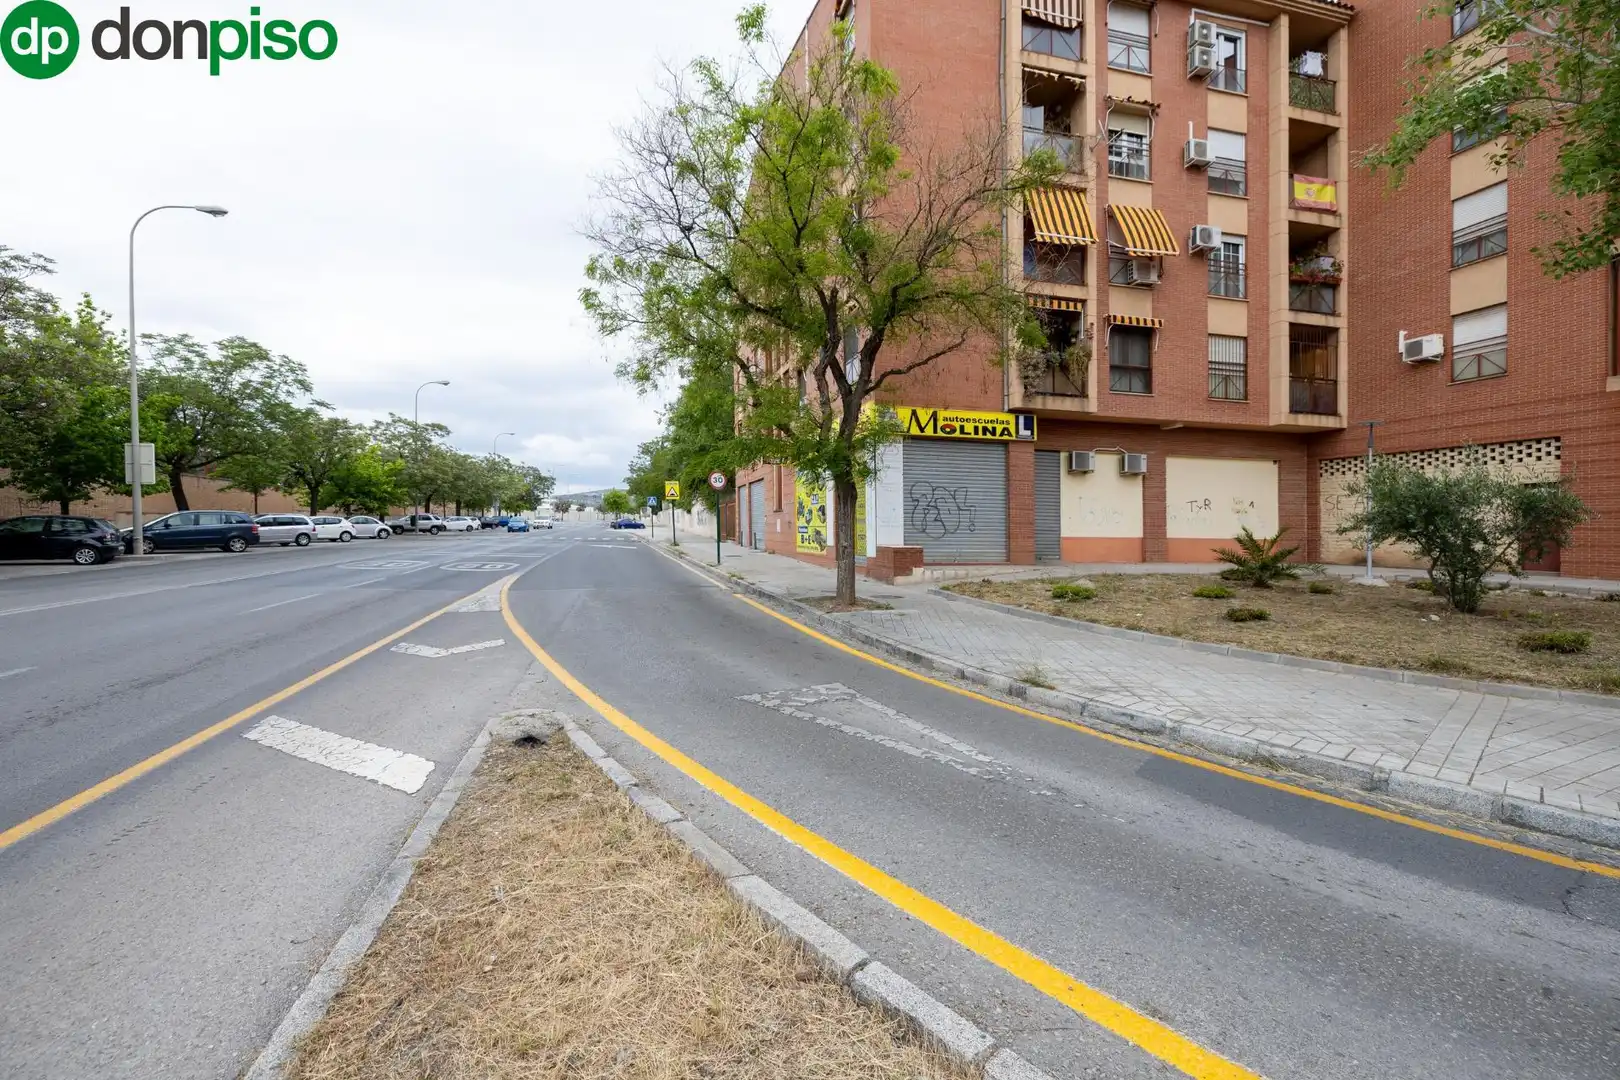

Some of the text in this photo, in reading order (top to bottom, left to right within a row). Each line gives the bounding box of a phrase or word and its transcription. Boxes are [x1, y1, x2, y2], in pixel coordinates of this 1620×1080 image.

[907, 409, 1013, 437] MOLINA
[942, 415, 1010, 426] autoescuelas
[713, 475, 724, 483] 30
